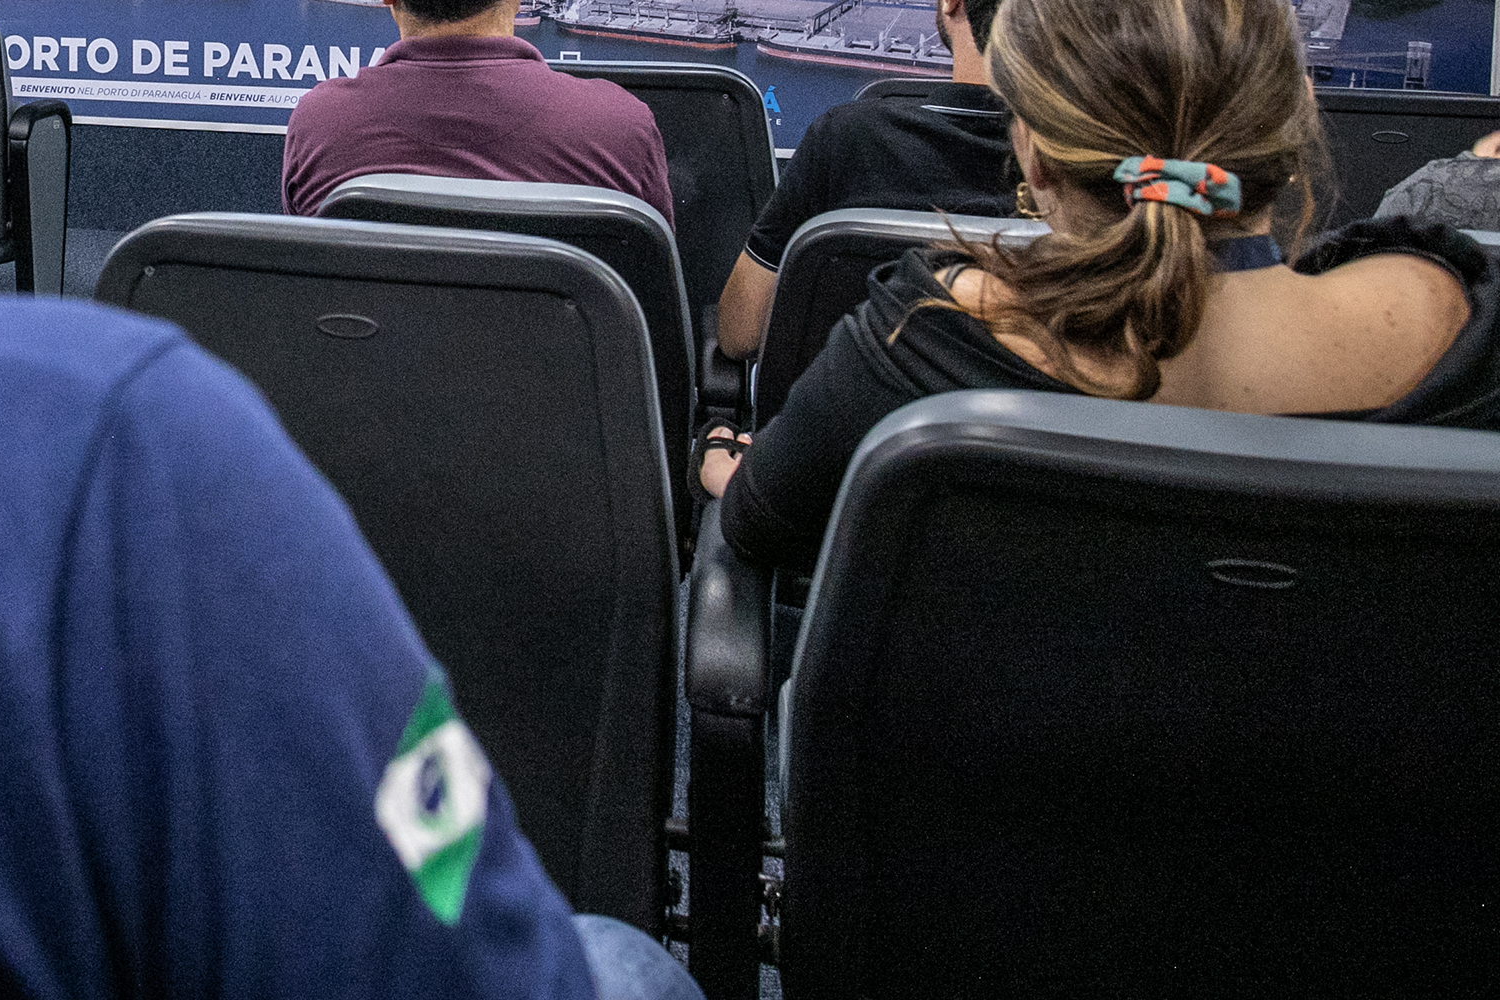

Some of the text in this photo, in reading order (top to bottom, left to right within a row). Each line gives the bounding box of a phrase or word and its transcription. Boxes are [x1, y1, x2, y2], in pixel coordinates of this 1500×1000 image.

[4, 35, 118, 74] ORTO
[132, 40, 189, 76] DE
[20, 84, 76, 94] BENVENUTO
[78, 87, 95, 96] NEL
[97, 87, 129, 97] PORTO
[131, 89, 141, 97] DI
[142, 89, 201, 100] PARANAGUÁ
[210, 93, 266, 102] BIENVENUE
[268, 95, 282, 103] AU
